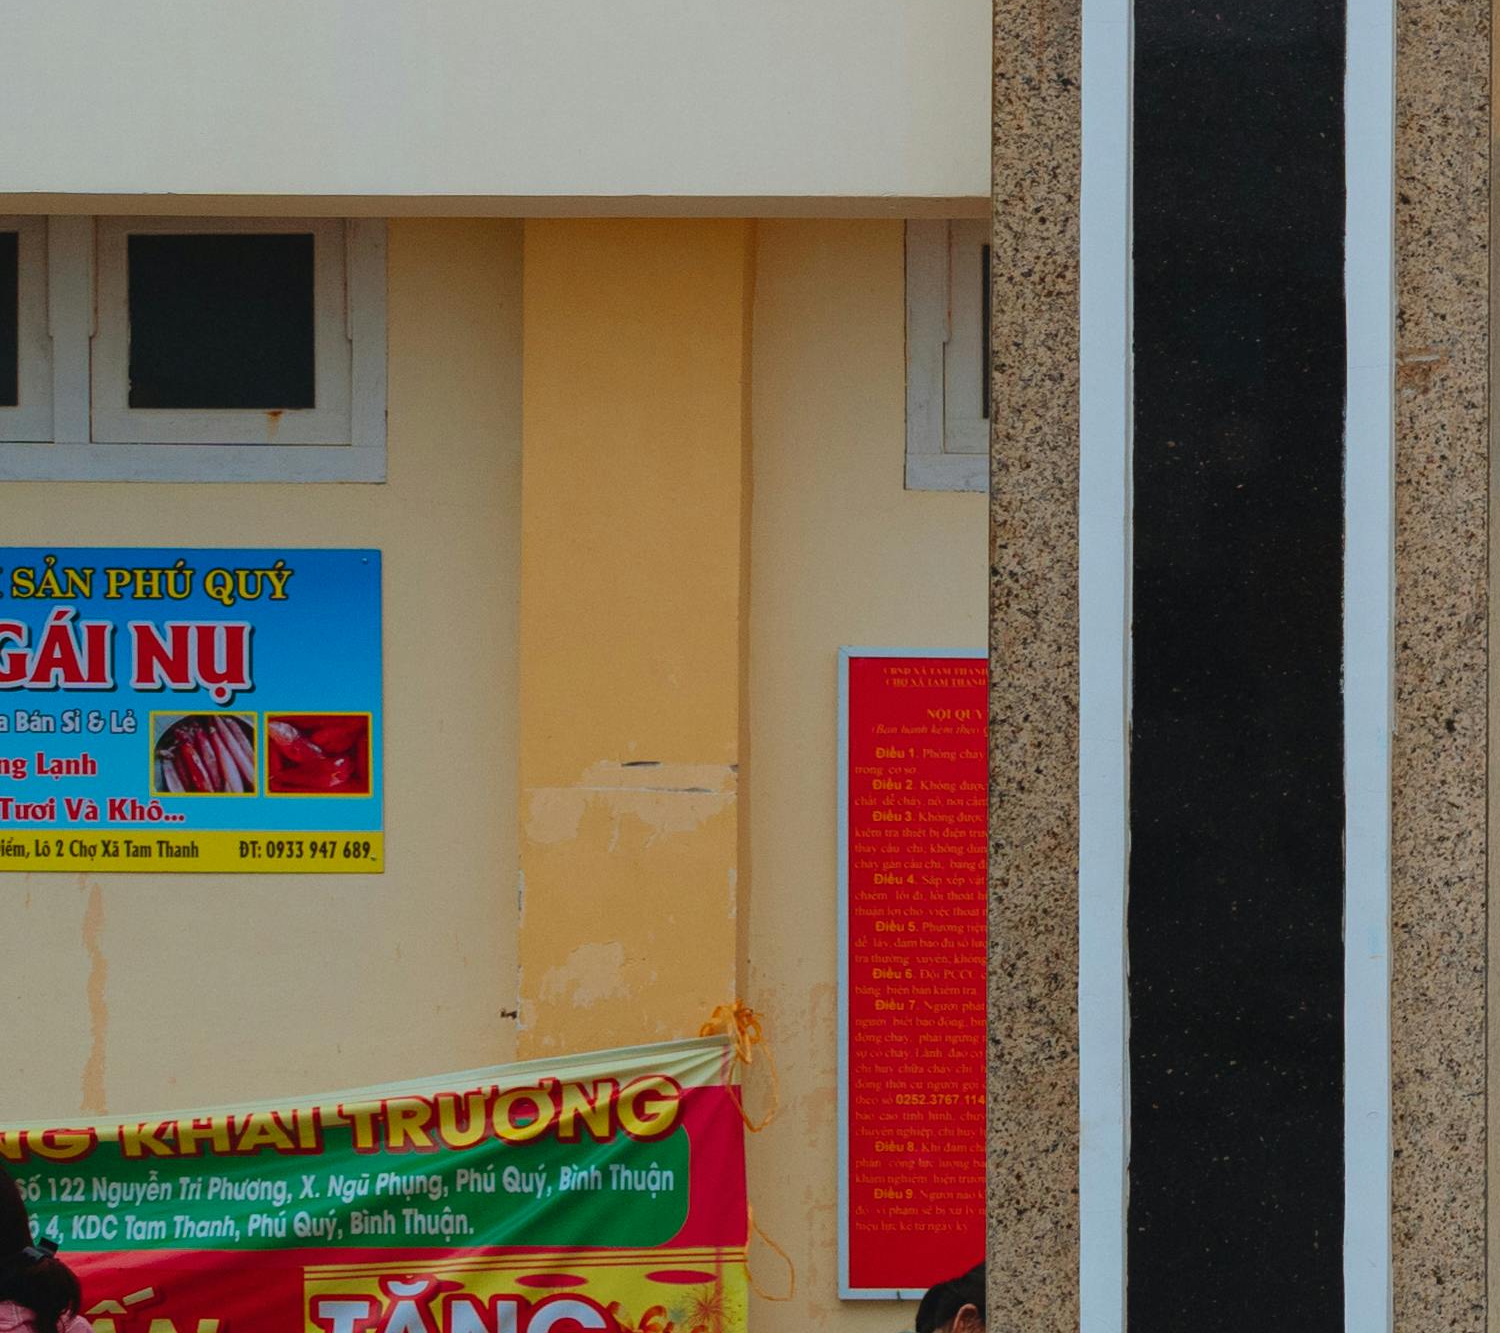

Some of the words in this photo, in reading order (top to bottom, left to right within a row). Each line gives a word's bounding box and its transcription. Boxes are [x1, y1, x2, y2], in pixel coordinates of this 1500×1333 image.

[11, 555, 95, 601] SẢN
[105, 560, 194, 601] PHÚ
[204, 560, 294, 607] QUÝ
[129, 620, 253, 704] NỤ
[15, 710, 55, 733] Bán
[87, 712, 105, 733] &
[111, 710, 137, 734] Lẻ
[36, 752, 98, 780] Lạnh
[0, 797, 57, 821] Tươi
[66, 797, 99, 821] Và
[107, 797, 186, 822] Khô...
[34, 838, 51, 858] Lô
[56, 840, 65, 857] 2
[69, 840, 97, 862] Chợ
[101, 839, 120, 858] Xã
[124, 840, 152, 858] Tam
[156, 839, 199, 858] Thanh
[239, 840, 262, 859] ĐT:
[266, 841, 304, 858] 0933
[309, 841, 338, 858] 947
[343, 840, 371, 858] 689
[117, 1107, 324, 1161] KHAI
[337, 1074, 683, 1155] TRƯƠNG
[49, 1177, 86, 1202] 122
[92, 1170, 172, 1208] Nguyễn
[207, 1176, 293, 1208] Phương,
[300, 1175, 321, 1198] X.
[337, 1173, 370, 1203] Ngũ
[375, 1172, 449, 1201] Phụng,
[456, 1165, 495, 1193] Phú
[502, 1164, 553, 1198] Quý,
[559, 1164, 602, 1191] Bình
[609, 1164, 674, 1198] Thuận
[71, 1215, 119, 1241] KDC
[125, 1215, 167, 1240] Tam
[173, 1214, 241, 1242] Thanh,
[248, 1210, 287, 1238] Phú
[293, 1209, 343, 1240] Quý,
[350, 1209, 397, 1234] Bình
[402, 1208, 475, 1242] Thuận.
